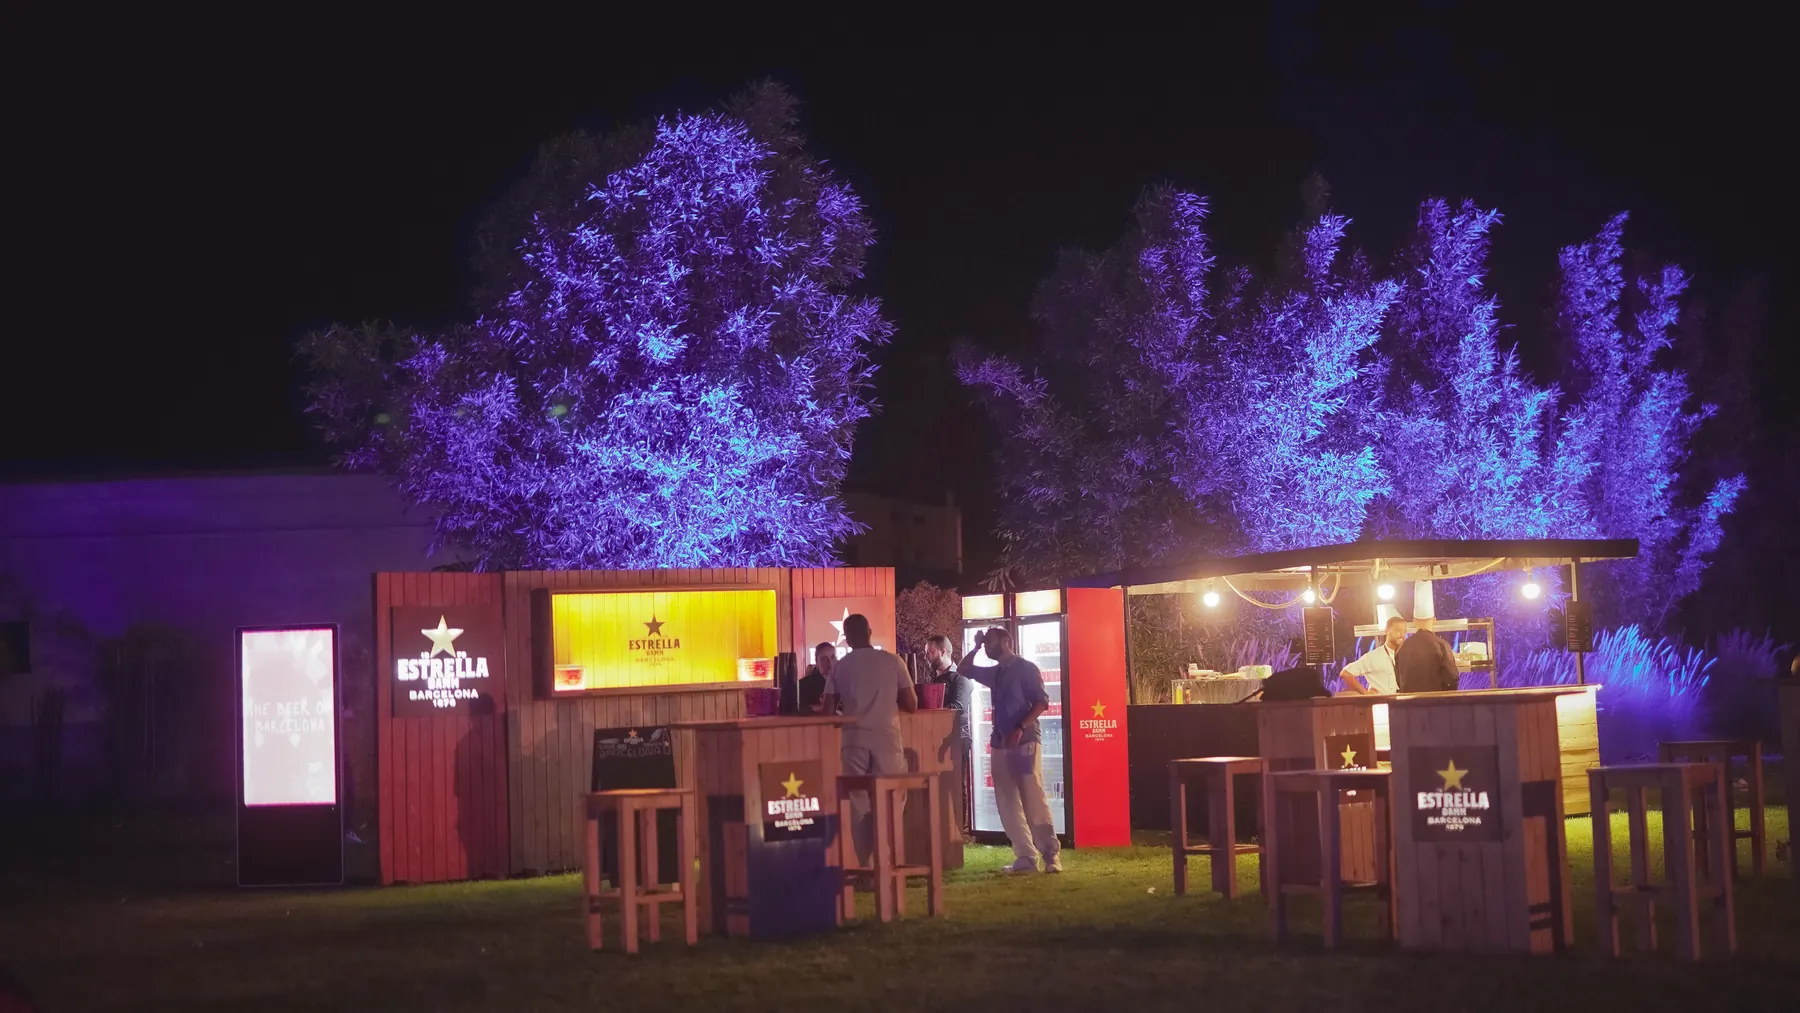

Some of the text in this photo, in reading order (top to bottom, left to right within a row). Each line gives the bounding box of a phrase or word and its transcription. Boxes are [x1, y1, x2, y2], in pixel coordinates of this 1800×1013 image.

[629, 639, 680, 650] ESTRELLA
[397, 657, 489, 681] ESTRELLA
[409, 688, 479, 701] BARCELONA
[276, 696, 311, 717] BEER
[254, 717, 326, 734] BARCELONA
[1080, 720, 1117, 728] ESTRELLA
[768, 798, 820, 815] ESTRELLA
[1417, 791, 1490, 810] ESTRELLA
[1426, 816, 1482, 826] BARCELONA
